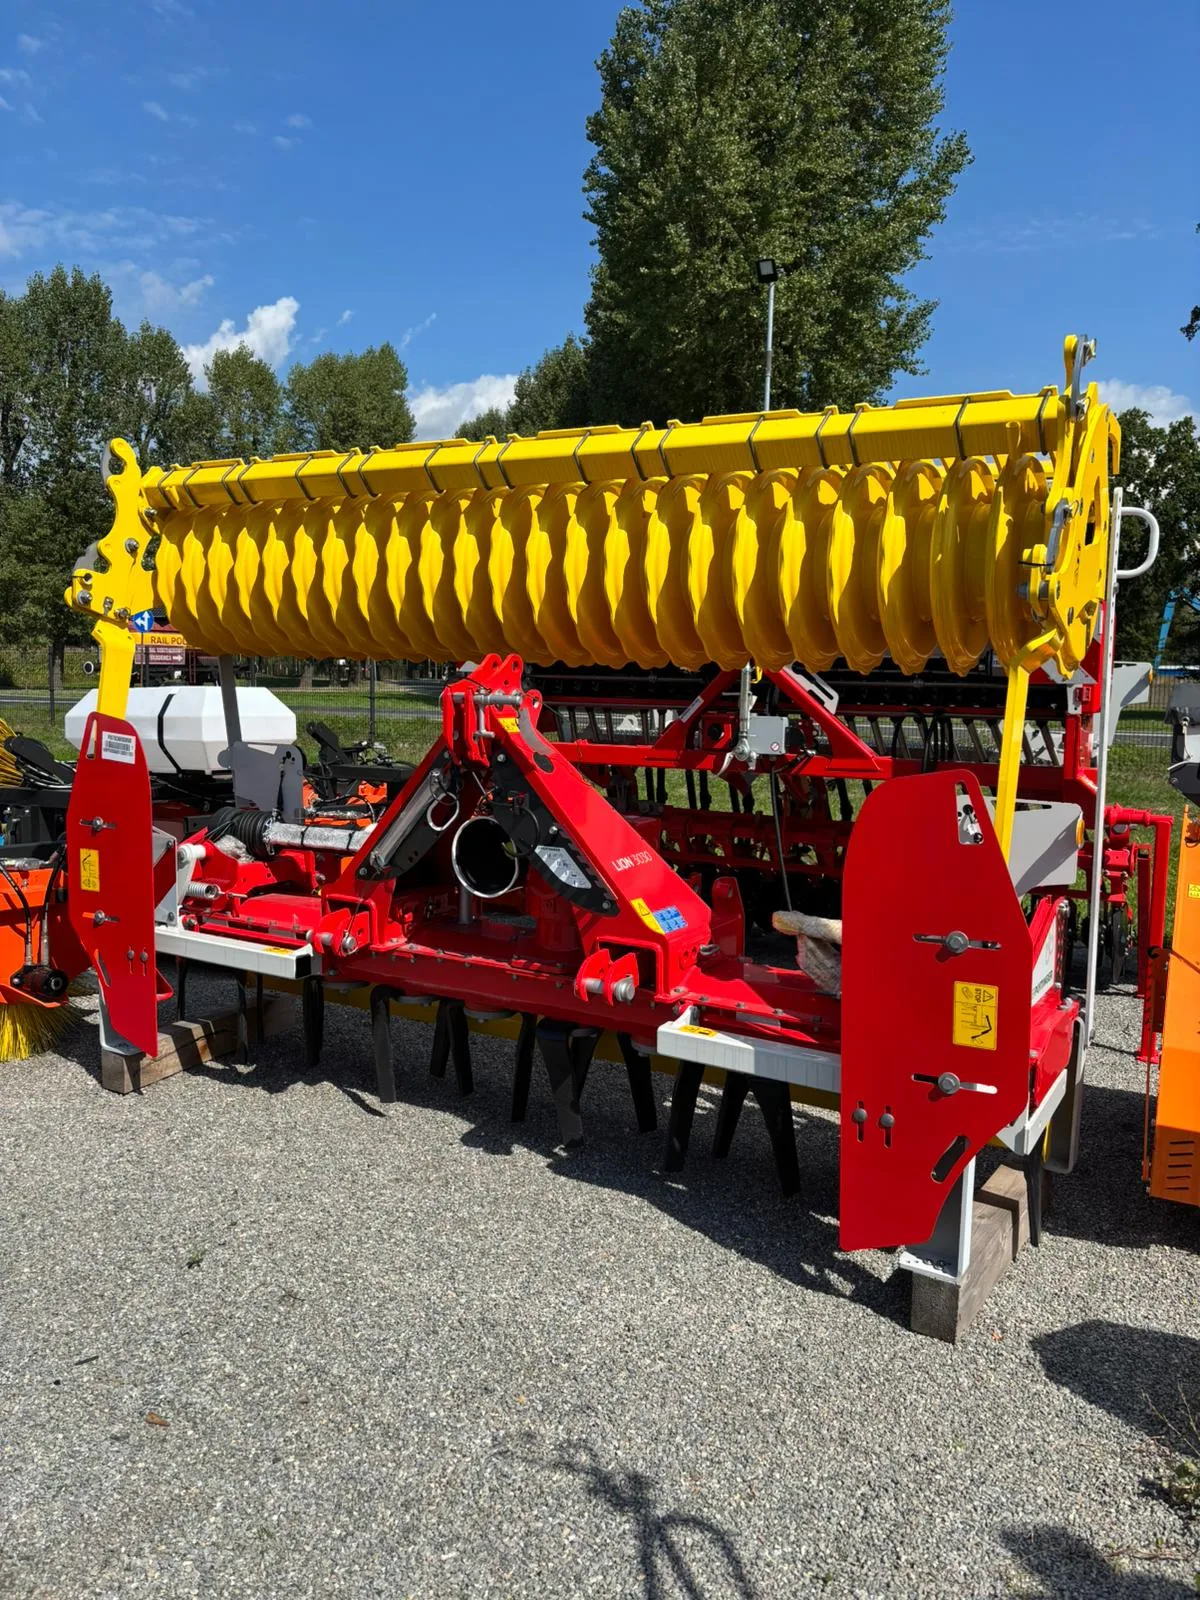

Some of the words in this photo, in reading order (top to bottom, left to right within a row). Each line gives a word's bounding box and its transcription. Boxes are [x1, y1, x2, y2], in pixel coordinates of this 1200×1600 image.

[150, 636, 170, 645] RAIL
[611, 856, 635, 872] LION
[630, 850, 653, 866] 3030
[974, 987, 982, 1003] STOP
